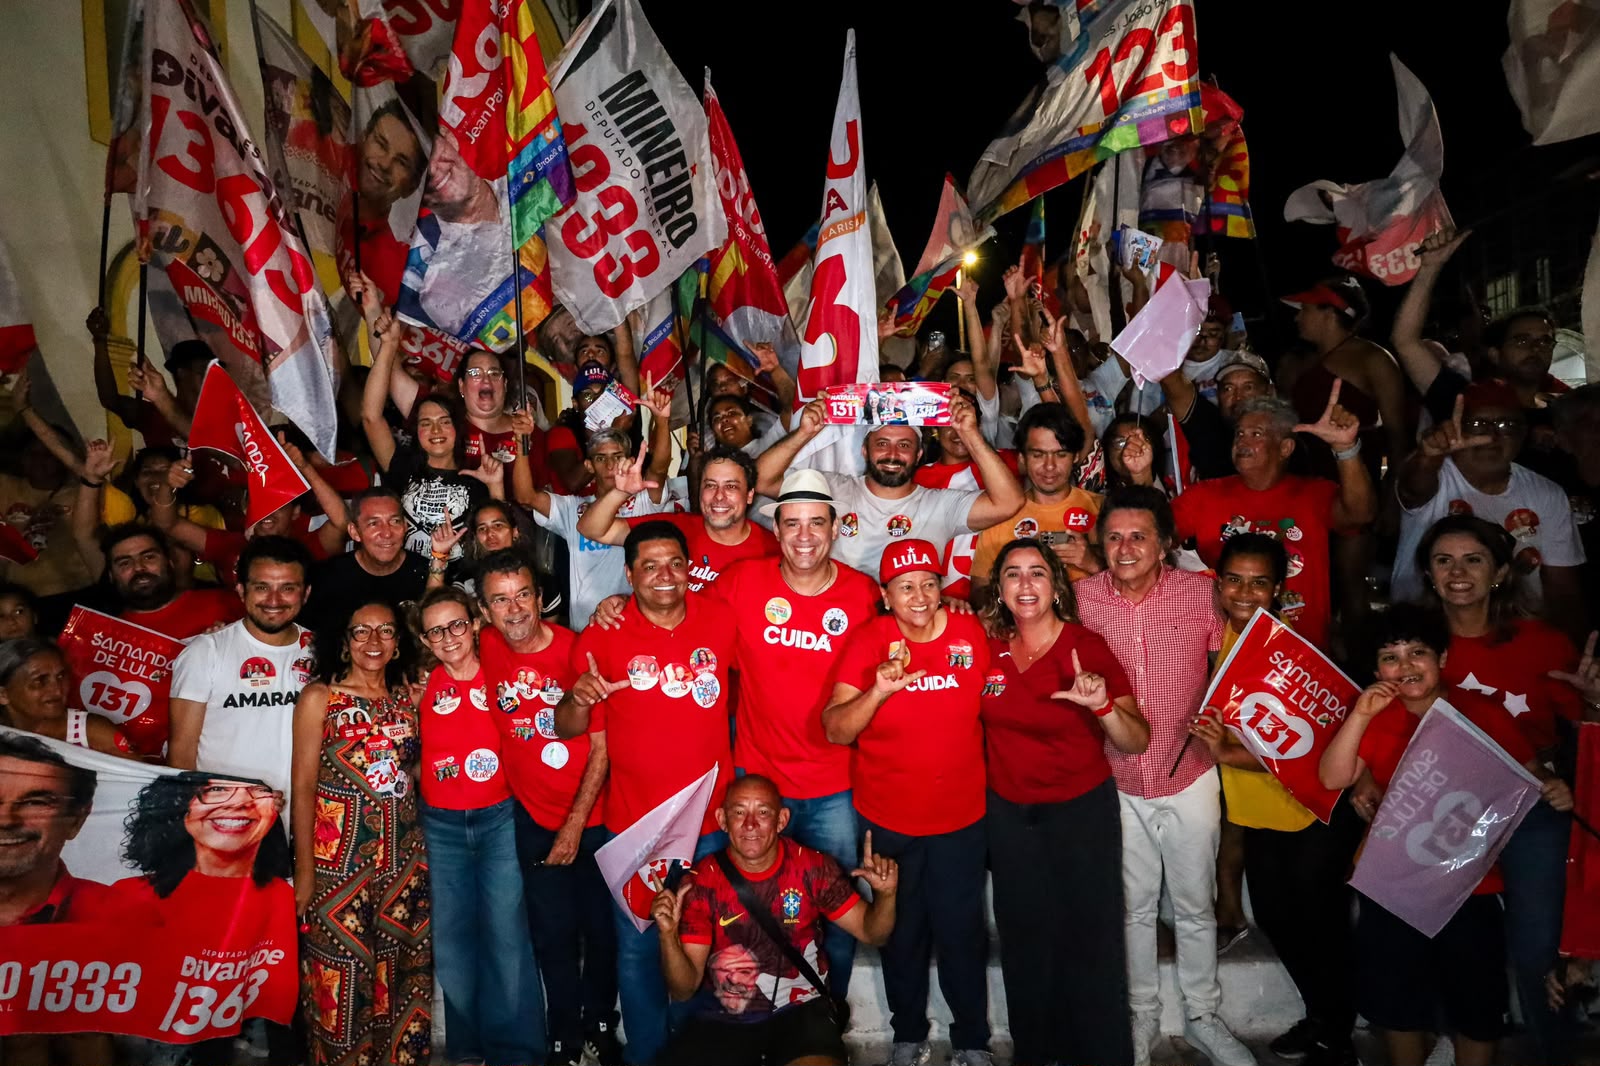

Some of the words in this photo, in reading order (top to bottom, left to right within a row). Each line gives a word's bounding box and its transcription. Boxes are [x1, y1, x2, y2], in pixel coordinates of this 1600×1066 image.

[1084, 4, 1198, 117] 123
[464, 110, 492, 145] Jean
[585, 101, 641, 181] DEPUTADO
[639, 186, 673, 259] FEDERAL
[598, 69, 698, 249] MINEIRO
[584, 367, 608, 378] LULA
[830, 401, 858, 417] 1311
[420, 500, 447, 508] POVO
[893, 552, 932, 569] LULA
[93, 650, 118, 669] DE
[118, 659, 161, 683] LULA
[1268, 650, 1348, 722] SAMANDA
[88, 682, 140, 717] 131
[1264, 668, 1292, 695] DE
[1287, 687, 1329, 729] LULA
[1245, 701, 1302, 756] 131
[27, 959, 142, 1013] 1333
